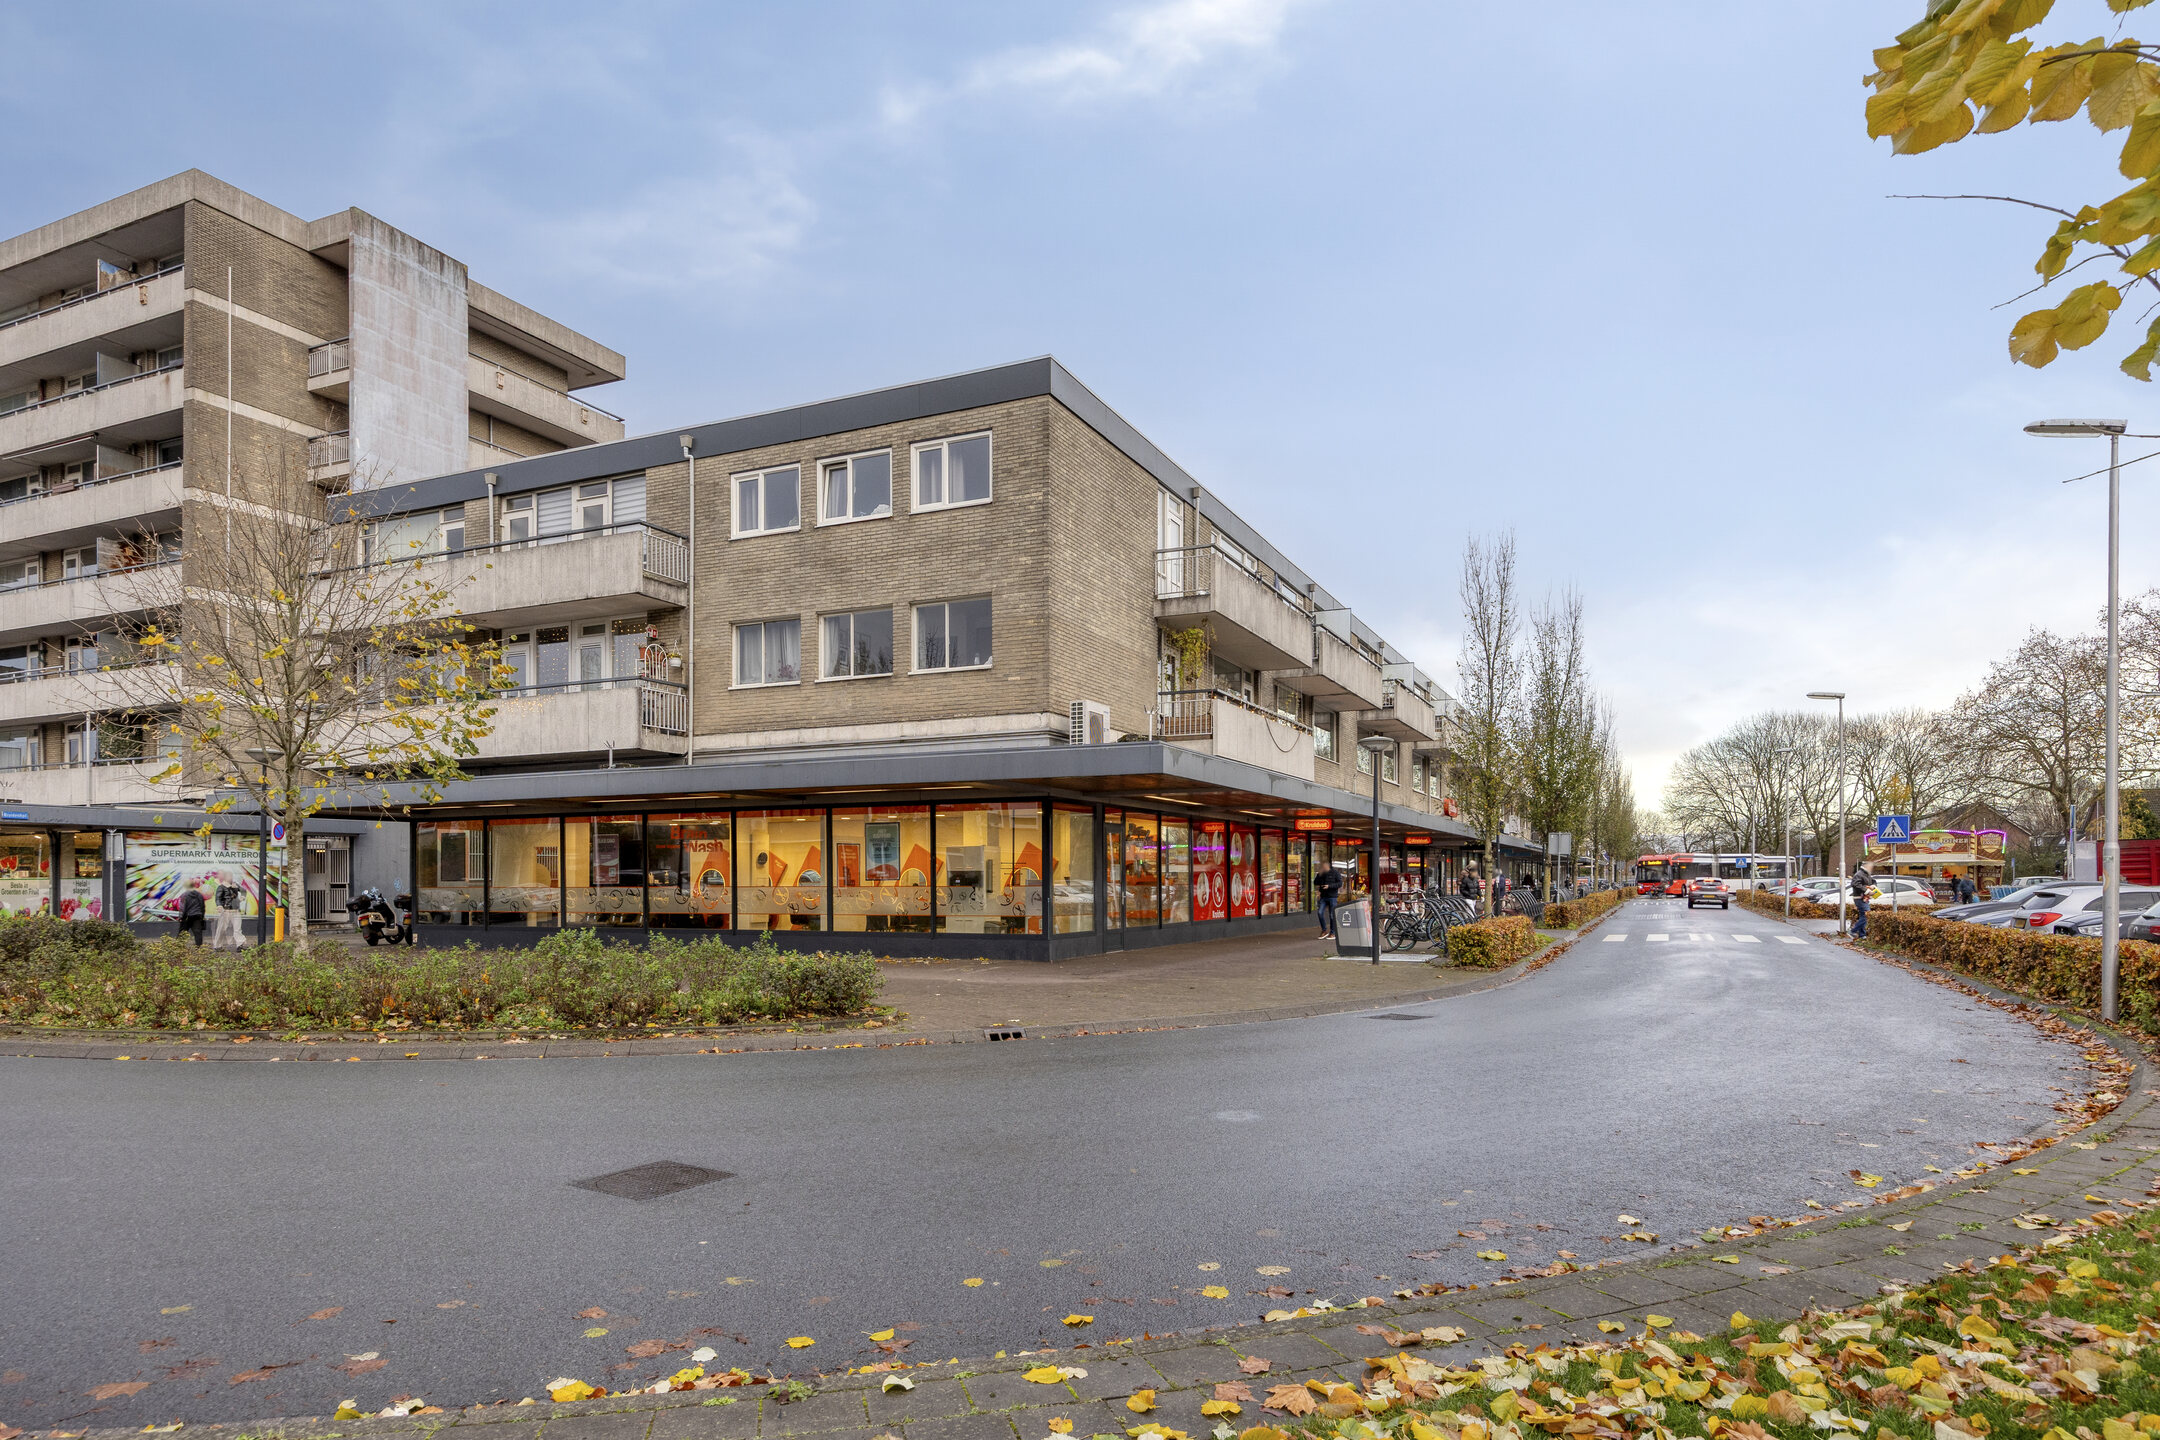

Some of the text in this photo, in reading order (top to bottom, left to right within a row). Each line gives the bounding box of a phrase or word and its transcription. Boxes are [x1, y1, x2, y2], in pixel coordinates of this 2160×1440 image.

[670, 825, 708, 840] Brain
[683, 838, 724, 853] Wash
[151, 850, 270, 859] SUPERMARKT VAARTBROK
